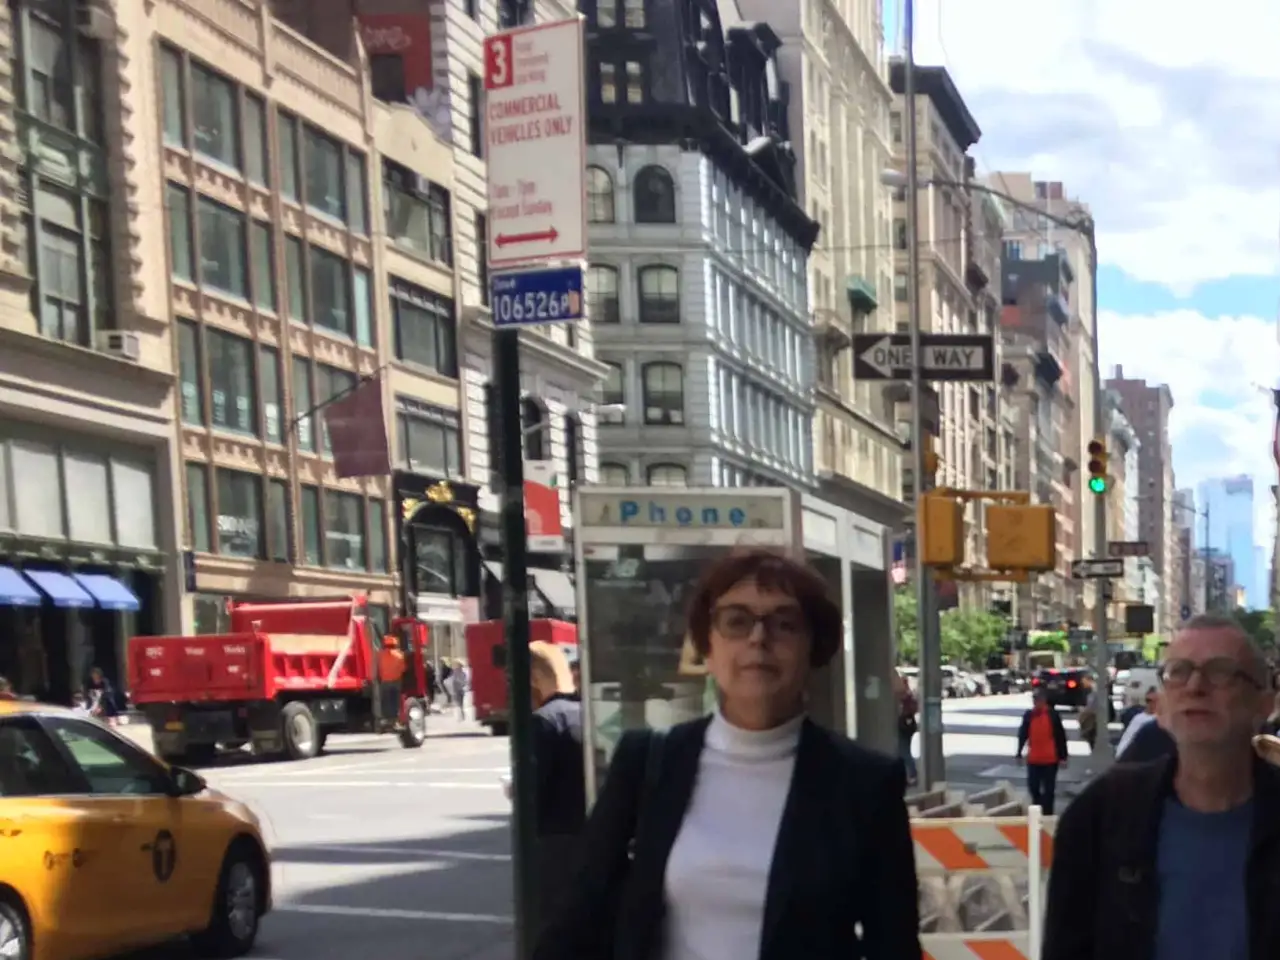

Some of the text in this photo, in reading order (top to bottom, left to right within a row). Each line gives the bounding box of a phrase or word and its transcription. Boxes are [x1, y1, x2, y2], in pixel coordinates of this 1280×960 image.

[491, 40, 507, 84] 3
[490, 93, 561, 120] COMMERCIAL
[490, 116, 572, 146] VEHICLES ONLY
[874, 347, 975, 367] ONE WAY
[620, 500, 746, 527] Phone
